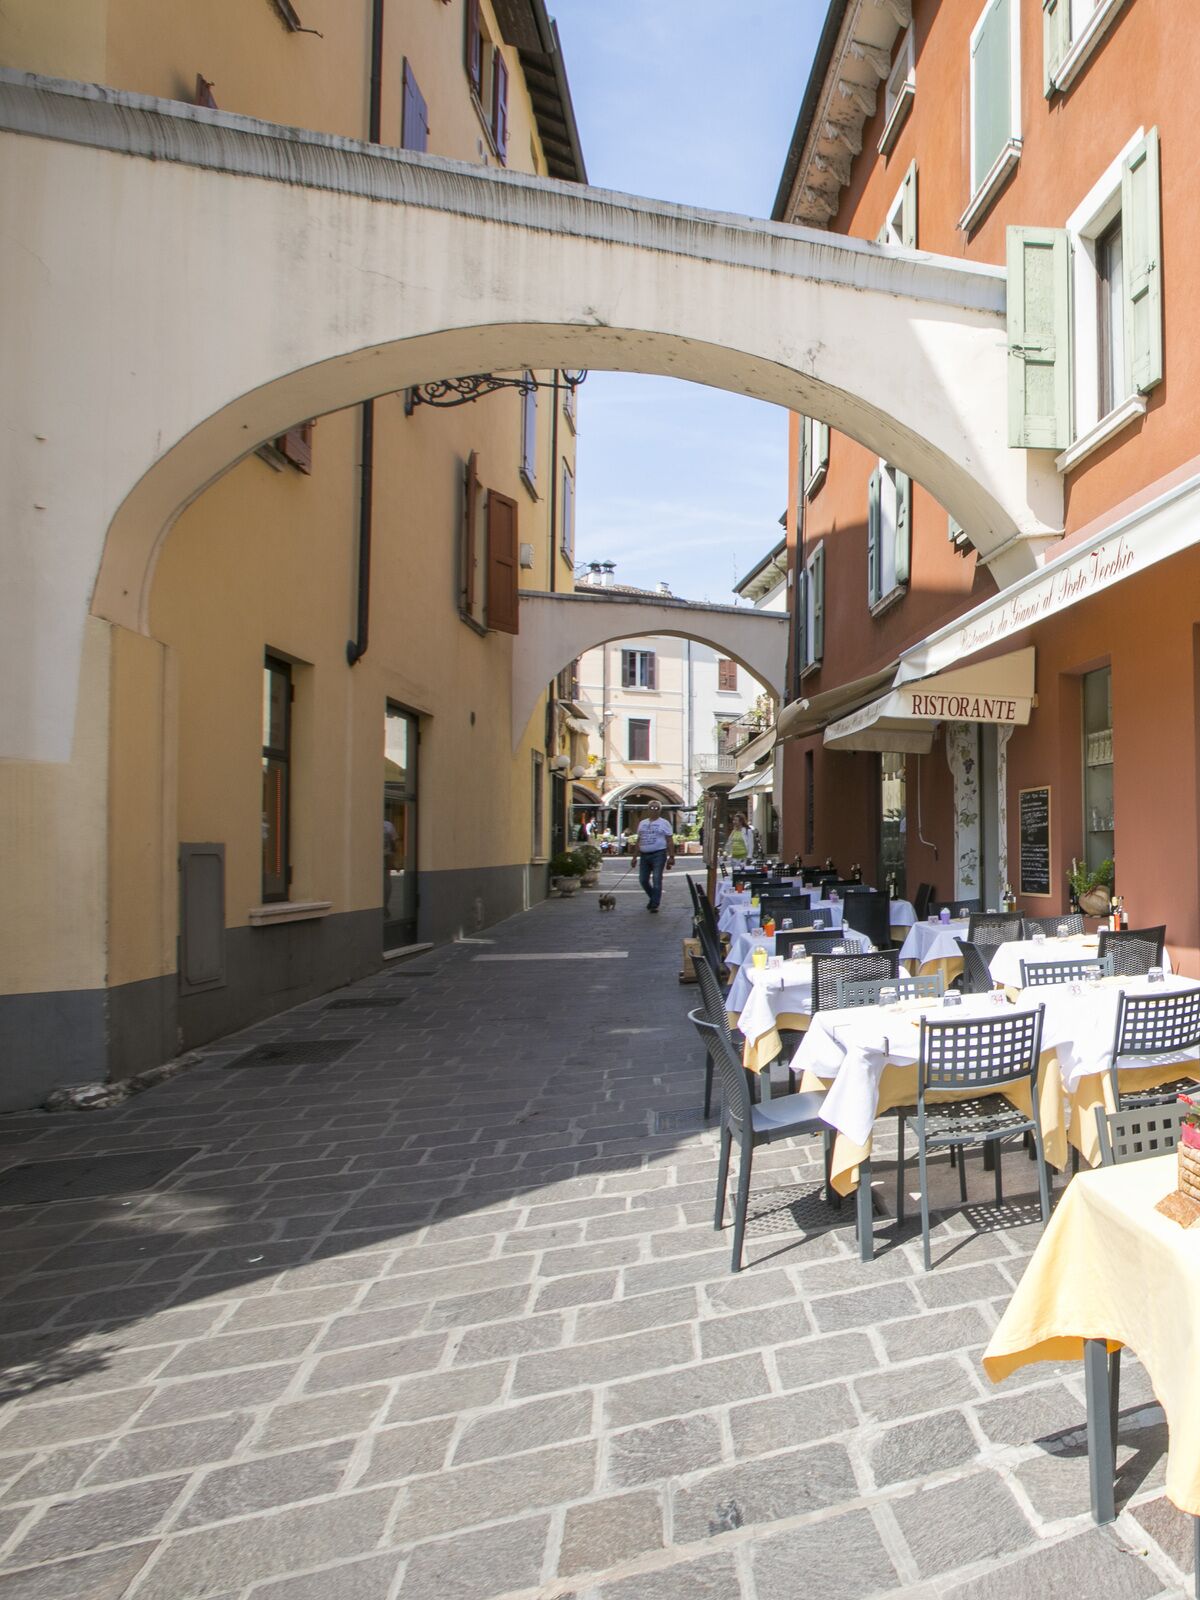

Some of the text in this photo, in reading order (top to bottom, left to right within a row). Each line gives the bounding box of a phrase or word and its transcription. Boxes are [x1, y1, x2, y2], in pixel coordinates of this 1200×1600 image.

[1043, 575, 1056, 608] al
[1058, 567, 1087, 603] Porto
[1090, 535, 1135, 586] Vecchio
[911, 694, 1017, 720] RISTORANTE
